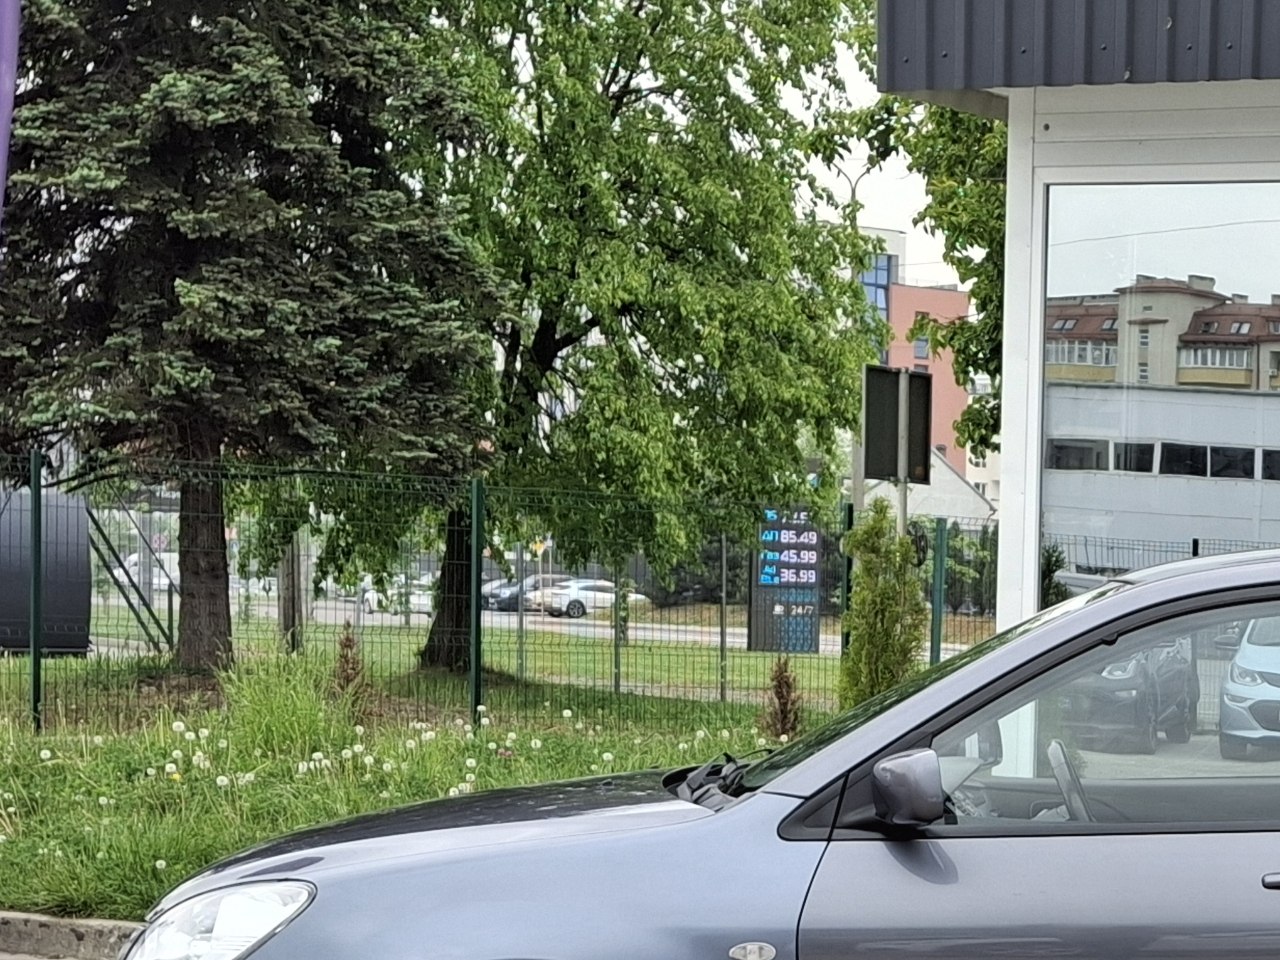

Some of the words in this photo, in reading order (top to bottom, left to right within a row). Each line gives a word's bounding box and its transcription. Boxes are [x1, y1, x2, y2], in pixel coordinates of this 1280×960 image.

[780, 530, 818, 544] 85.49
[780, 550, 817, 564] 45.99
[780, 568, 817, 583] 36.99
[791, 605, 814, 616] 24/7
